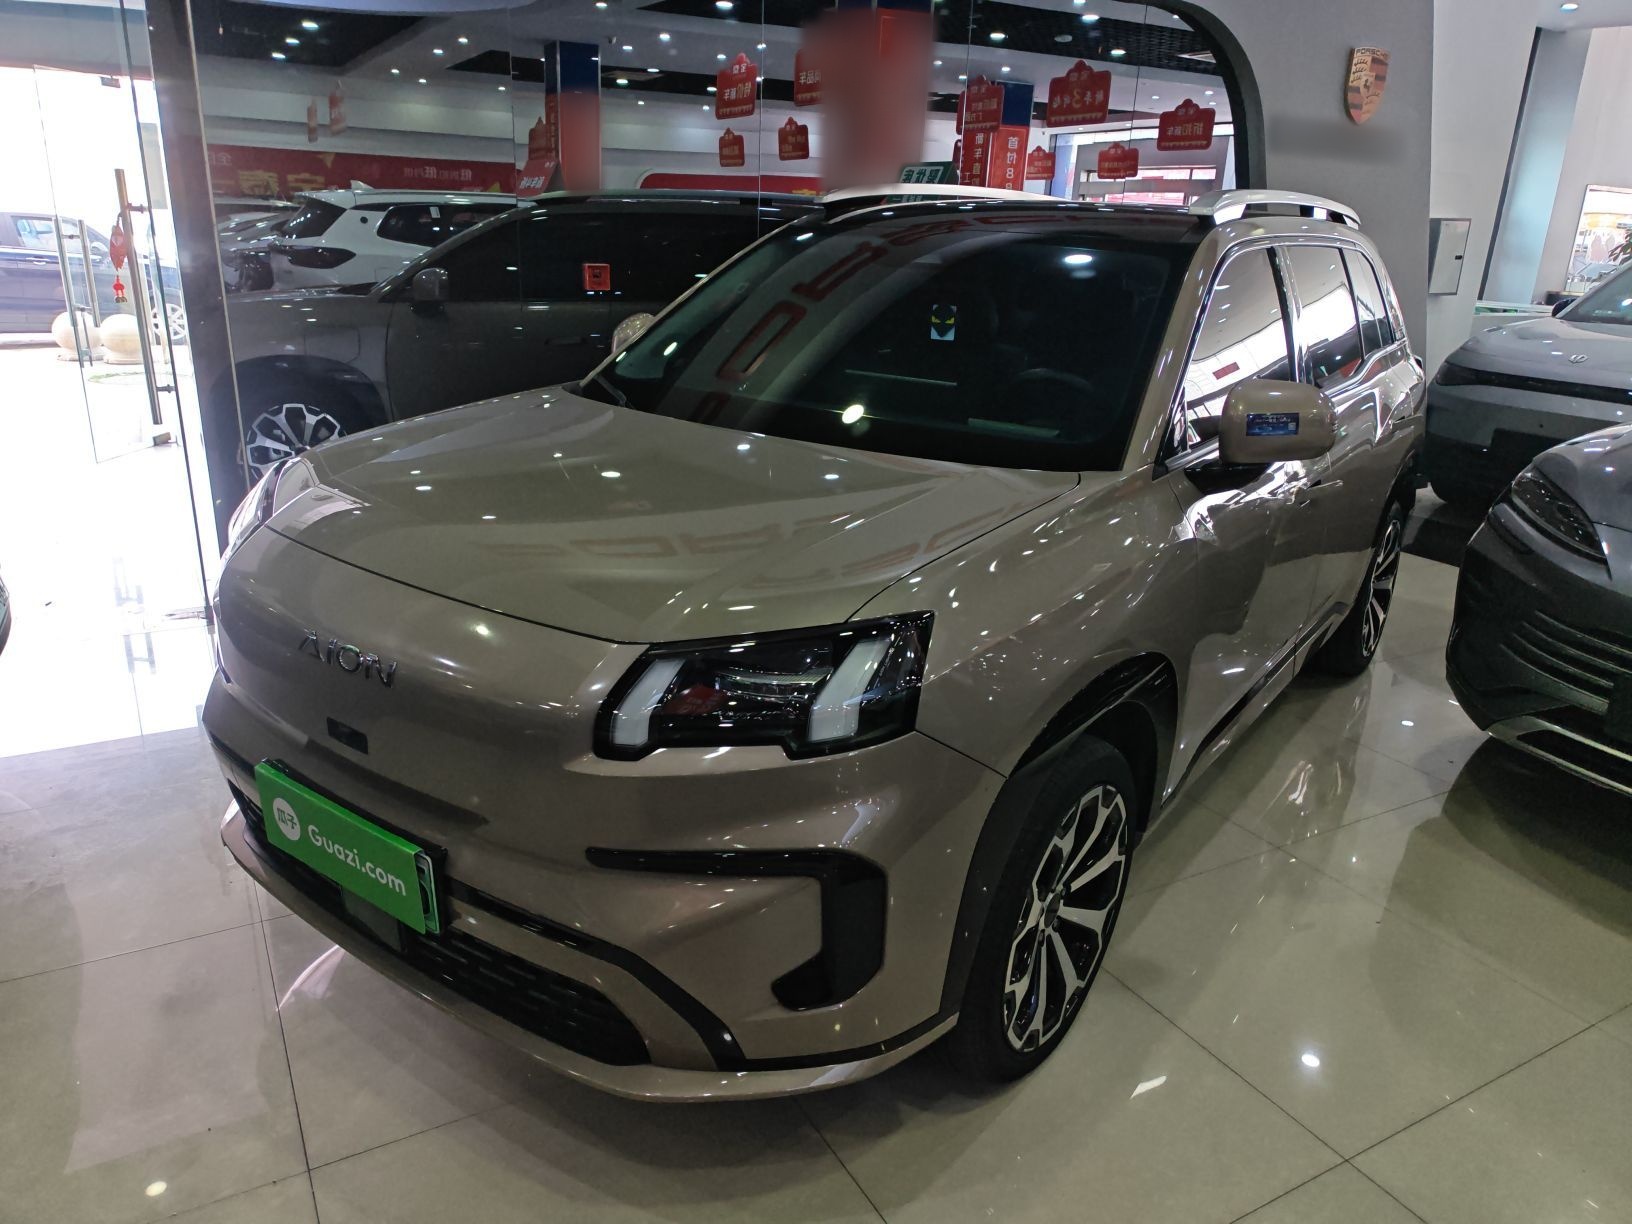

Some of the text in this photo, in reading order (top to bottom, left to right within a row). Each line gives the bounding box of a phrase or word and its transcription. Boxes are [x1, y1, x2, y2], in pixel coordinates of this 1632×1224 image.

[298, 630, 397, 689] AION
[276, 805, 298, 831] 瓜子
[307, 824, 407, 897] Guazi.com
